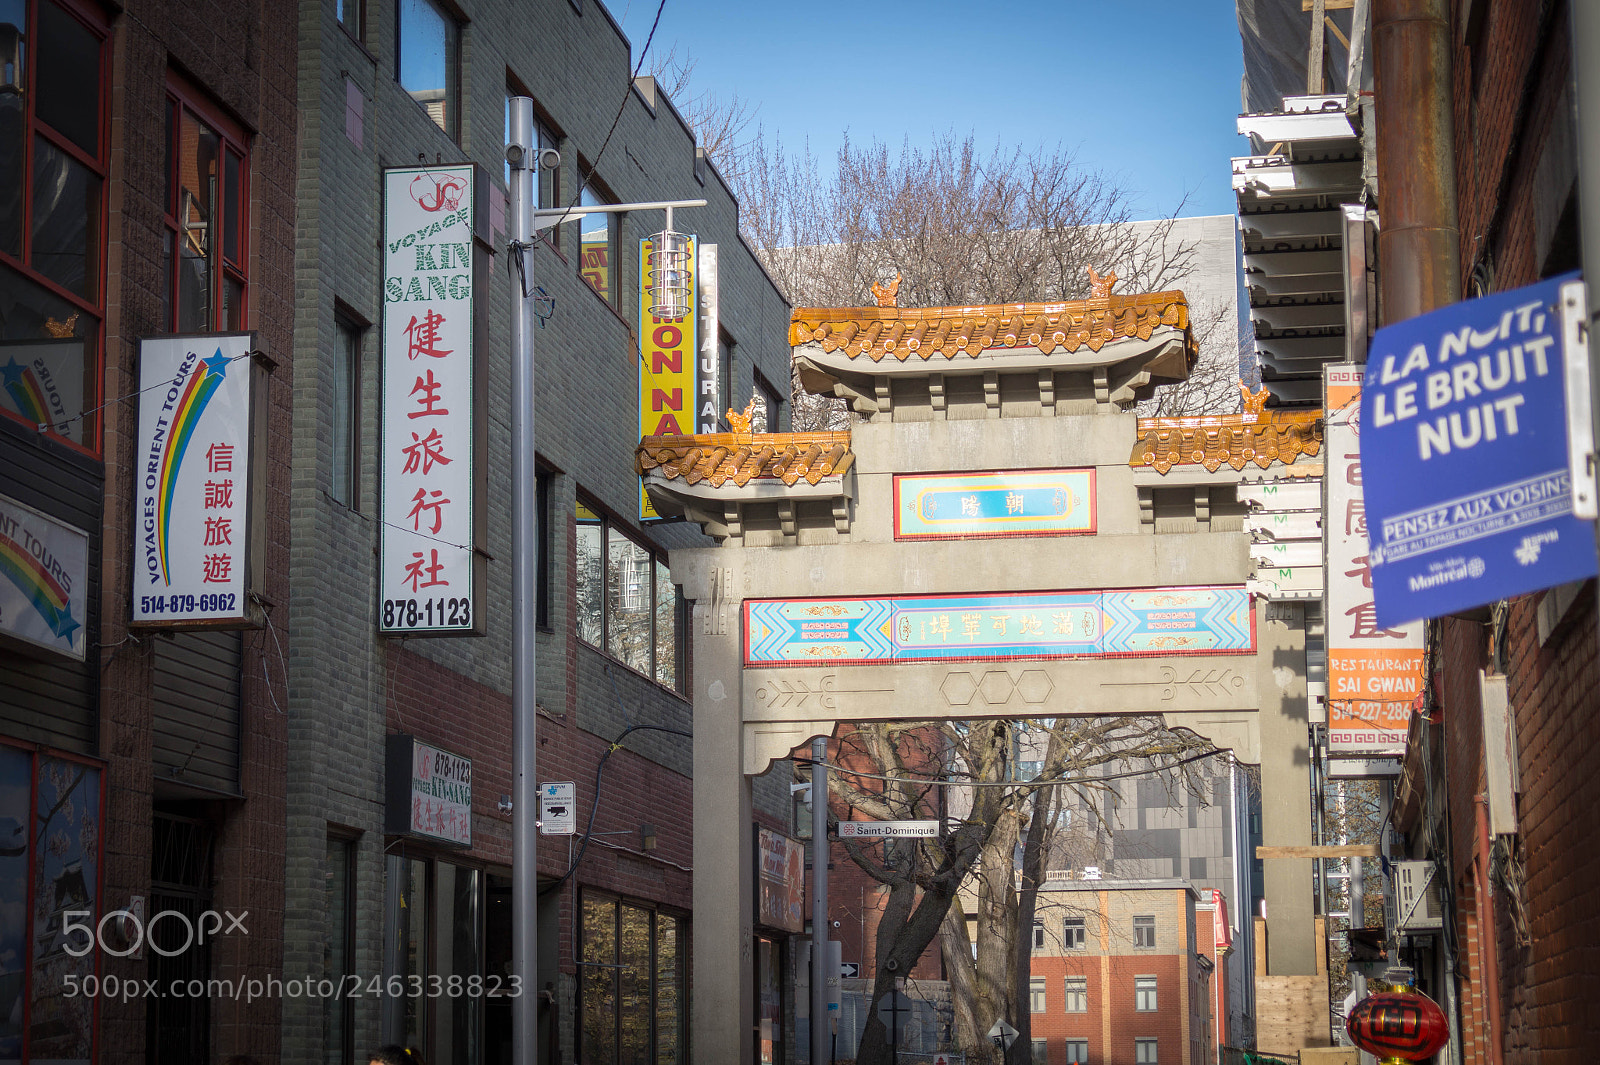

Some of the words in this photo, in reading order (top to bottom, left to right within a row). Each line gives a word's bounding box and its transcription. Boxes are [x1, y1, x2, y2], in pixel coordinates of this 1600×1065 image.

[389, 207, 468, 254] VOYAGE
[415, 242, 470, 271] KIN
[386, 275, 470, 303] SANG
[701, 251, 717, 434] RESTAURAN
[1382, 344, 1430, 386] LA
[163, 351, 197, 416] TOURS
[1374, 382, 1418, 428] LE
[1427, 336, 1554, 410] BRUIT
[652, 388, 683, 436] NA
[1418, 393, 1524, 460] NUIT
[145, 417, 168, 490] ORIENT
[402, 309, 454, 593] 健生旅行社
[203, 443, 234, 584] 信誠旅遊
[1384, 509, 1449, 541] PENSEZ
[1454, 497, 1492, 522] AUX
[1495, 475, 1570, 510] VOISINS
[24, 530, 72, 594] TOURS
[144, 496, 159, 584] VOYAGES
[141, 593, 235, 614] 514-879-6962
[383, 597, 471, 628] 878-1123
[1331, 658, 1421, 671] RESTAURANT
[1338, 677, 1361, 693] SAI
[1367, 677, 1416, 693] GWAN
[1333, 702, 1411, 720] 514-227-286
[434, 752, 470, 784] 878-1123
[857, 826, 935, 836] Saint-Dominique
